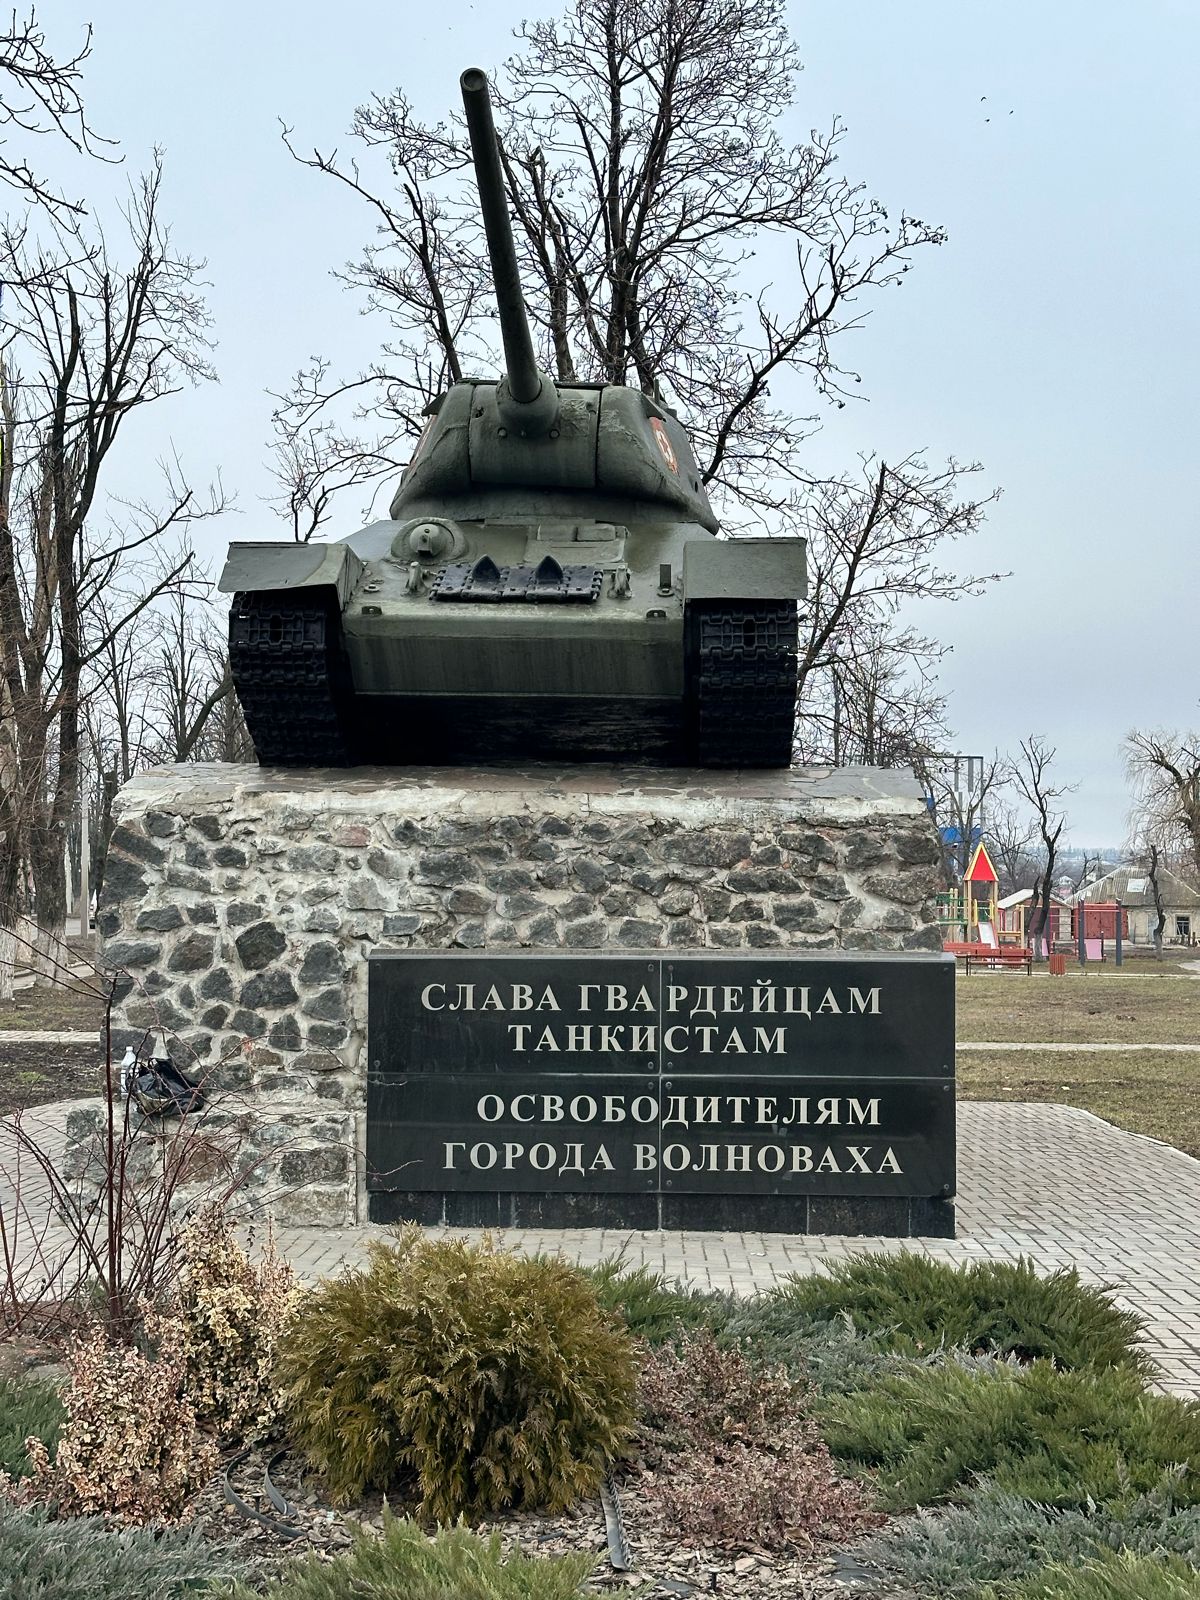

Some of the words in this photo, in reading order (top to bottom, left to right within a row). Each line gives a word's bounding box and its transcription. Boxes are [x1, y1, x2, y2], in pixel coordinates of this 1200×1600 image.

[422, 984, 561, 1010] СЛАВА
[579, 979, 882, 1020] ГВАРДЕЙЦАМ
[508, 1025, 787, 1053] ТАНКИСТАМ
[478, 1095, 881, 1129] ОСВОБОДИТЕЛЯМ
[443, 1143, 615, 1176] ГОРОДА
[634, 1144, 903, 1173] ВОЛНОВАХА
